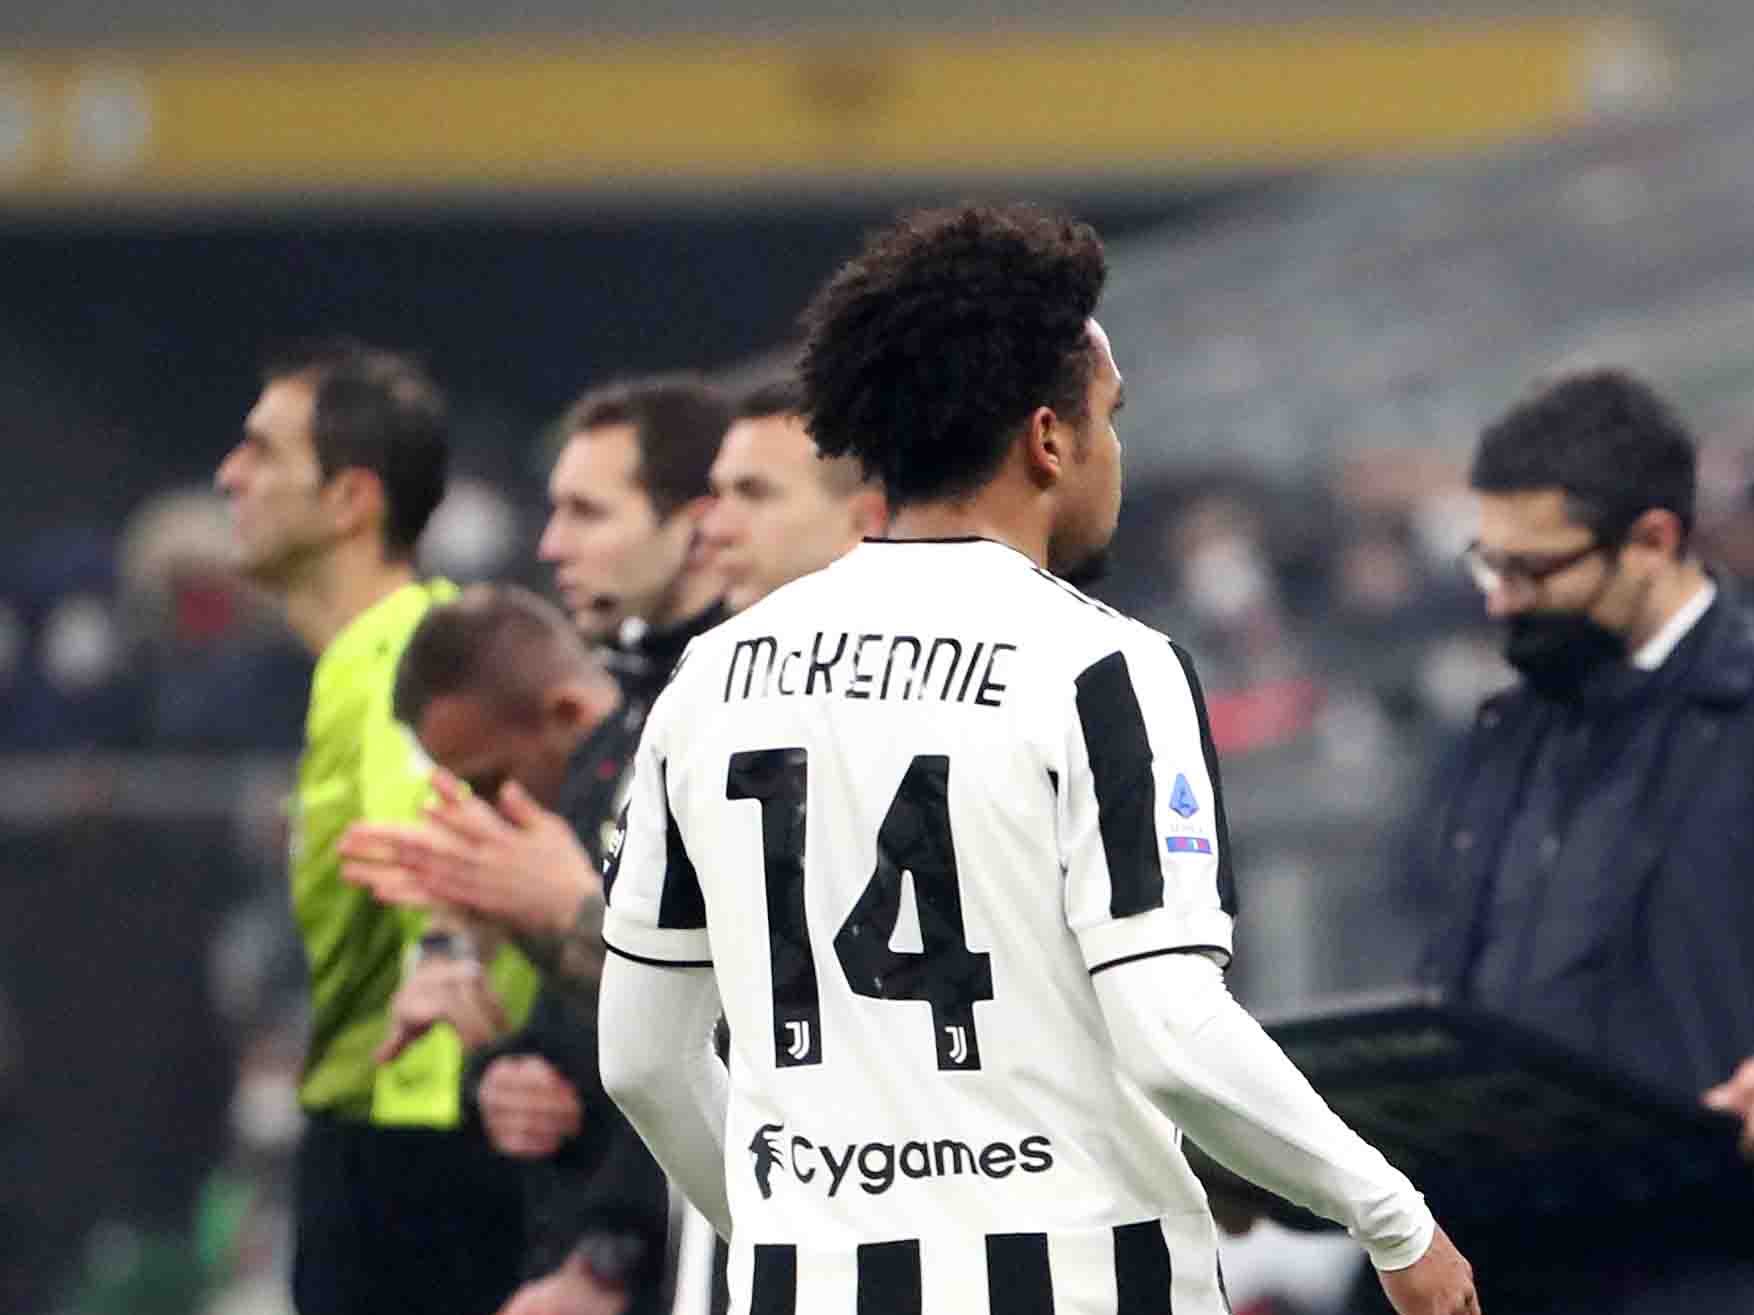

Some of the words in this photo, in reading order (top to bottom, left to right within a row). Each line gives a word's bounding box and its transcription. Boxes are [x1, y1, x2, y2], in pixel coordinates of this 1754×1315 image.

[723, 631, 1017, 707] McKENNIE
[725, 747, 994, 1071] 14
[791, 1135, 1054, 1198] Cygames
